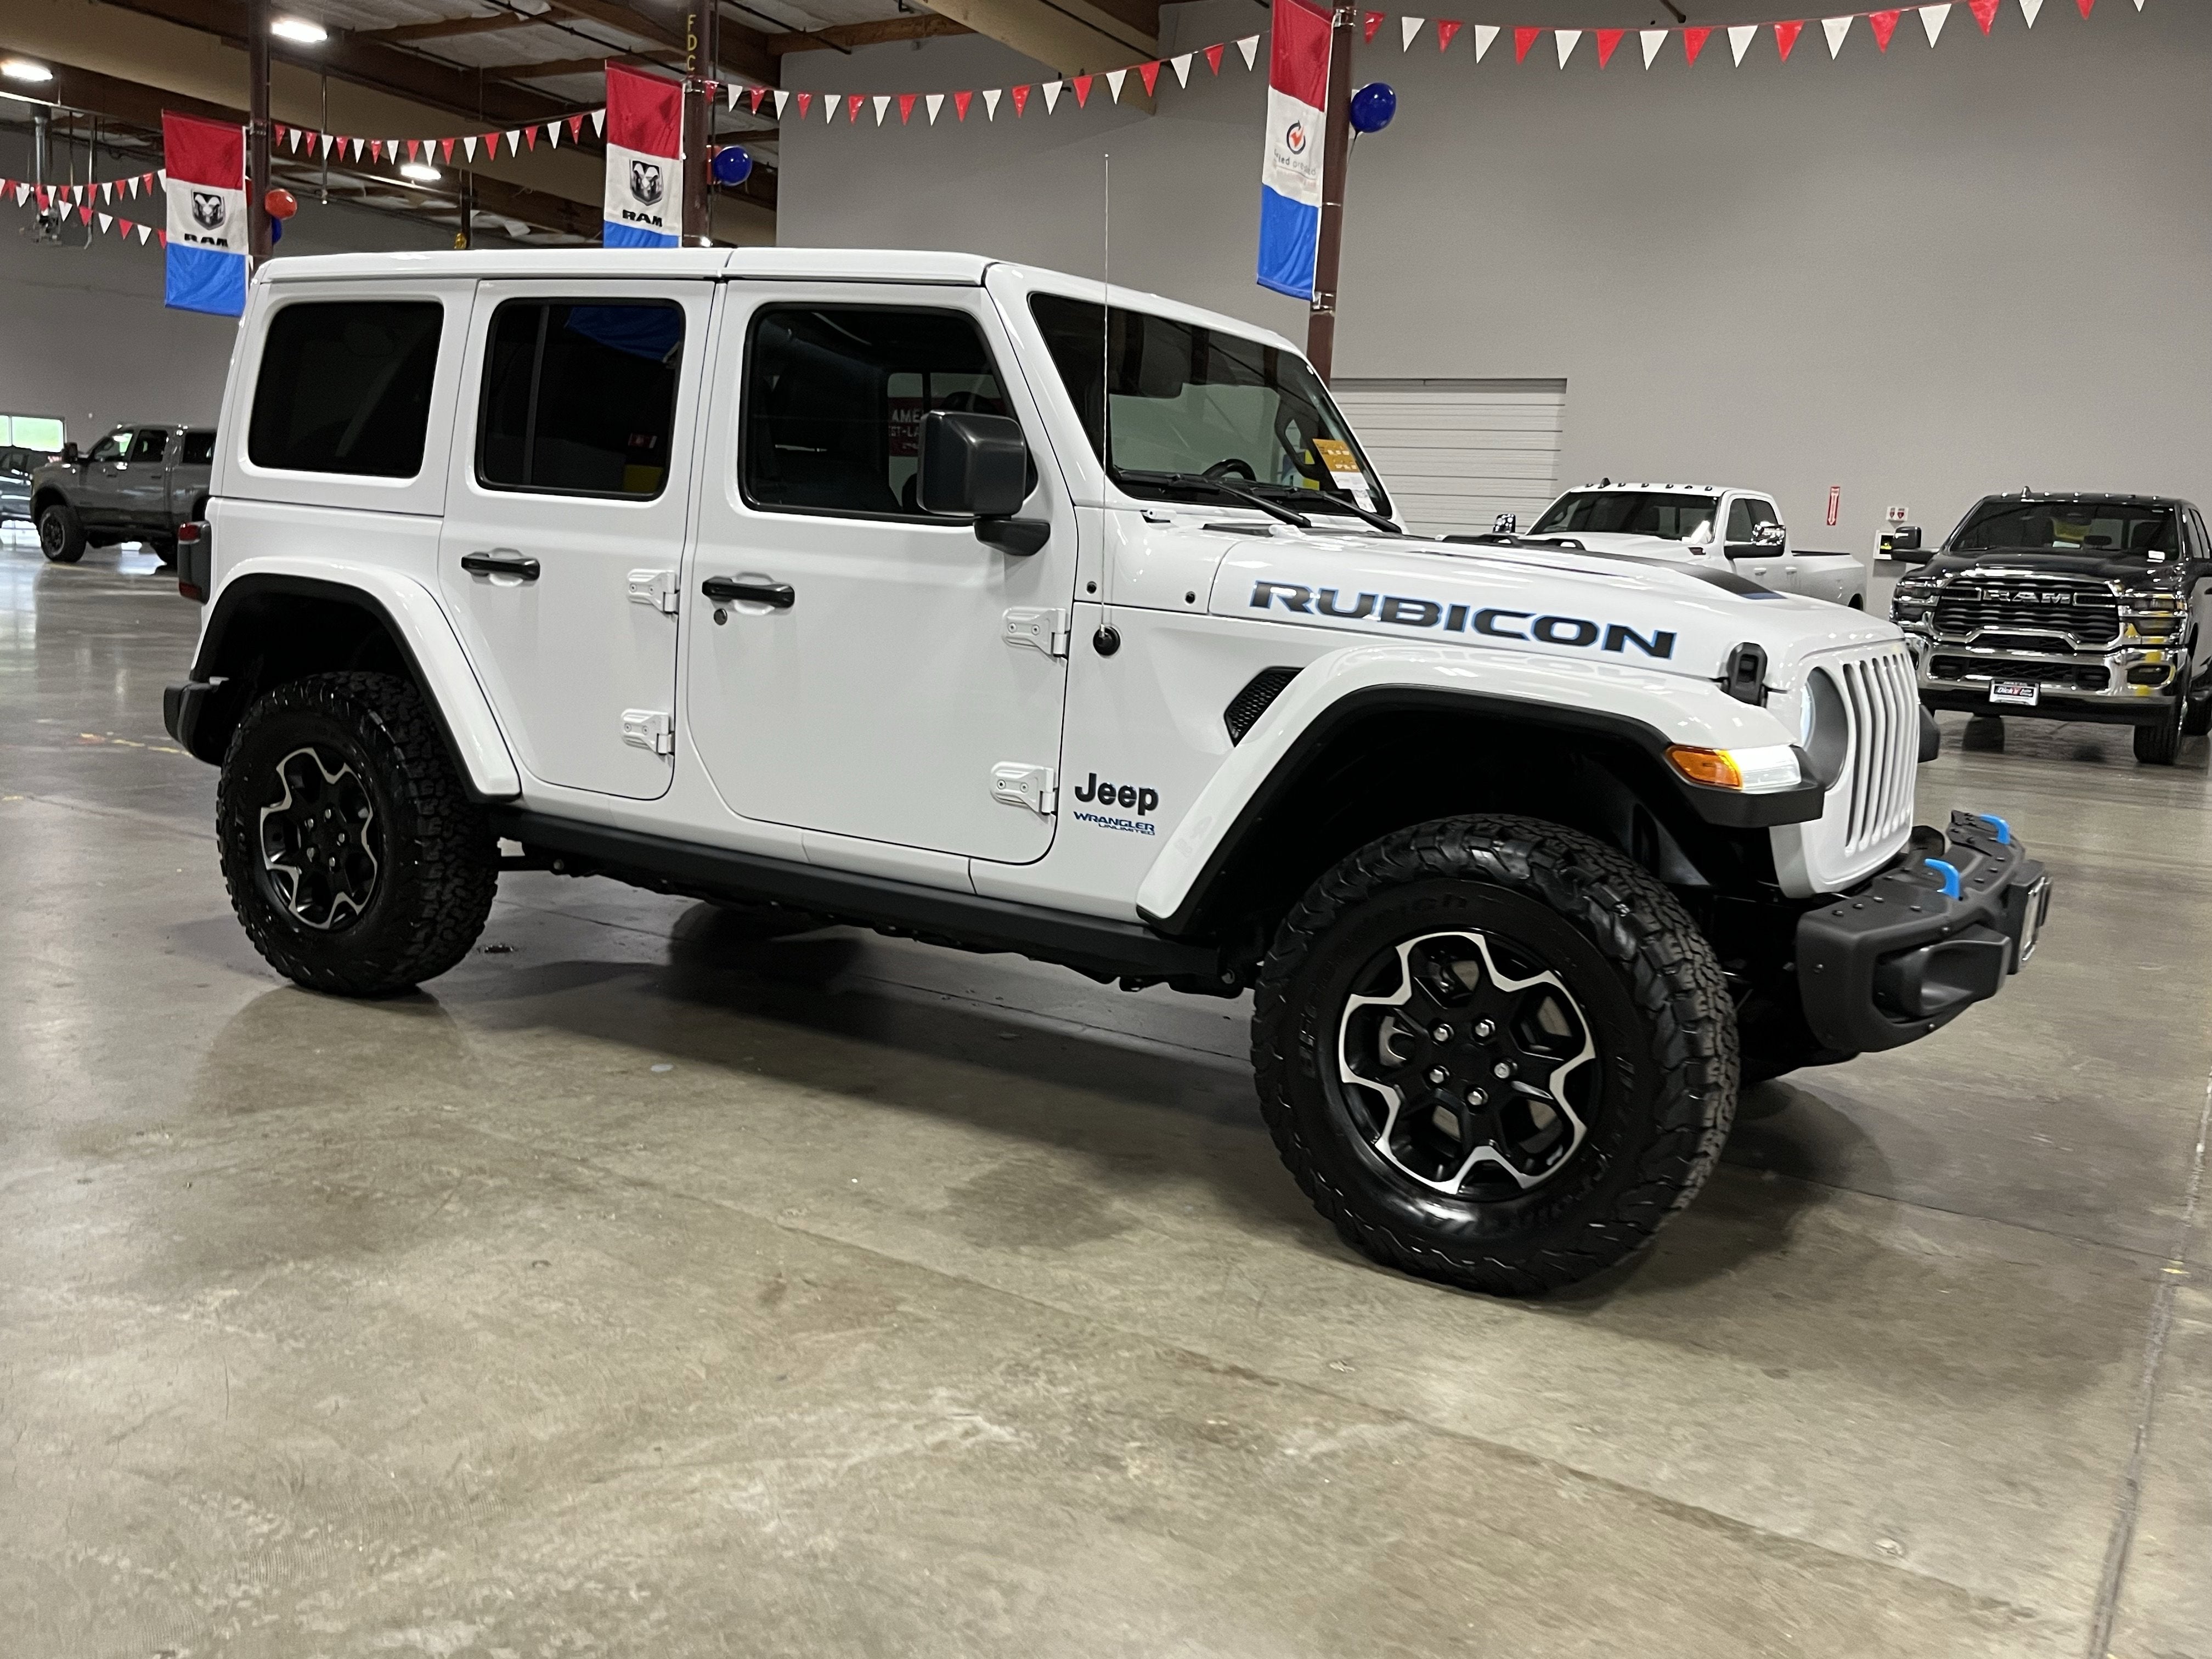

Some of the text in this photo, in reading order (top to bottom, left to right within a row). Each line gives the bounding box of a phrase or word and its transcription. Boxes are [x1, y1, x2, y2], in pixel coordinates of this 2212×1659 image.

[622, 209, 663, 228] RAM
[184, 233, 229, 248] RAM
[1983, 589, 2071, 604] RAM
[1249, 580, 1678, 661] RUBICON
[1075, 772, 1159, 816] Jeep
[1073, 811, 1155, 832] WRANGLER
[1098, 823, 1156, 836] UNLIMITED
